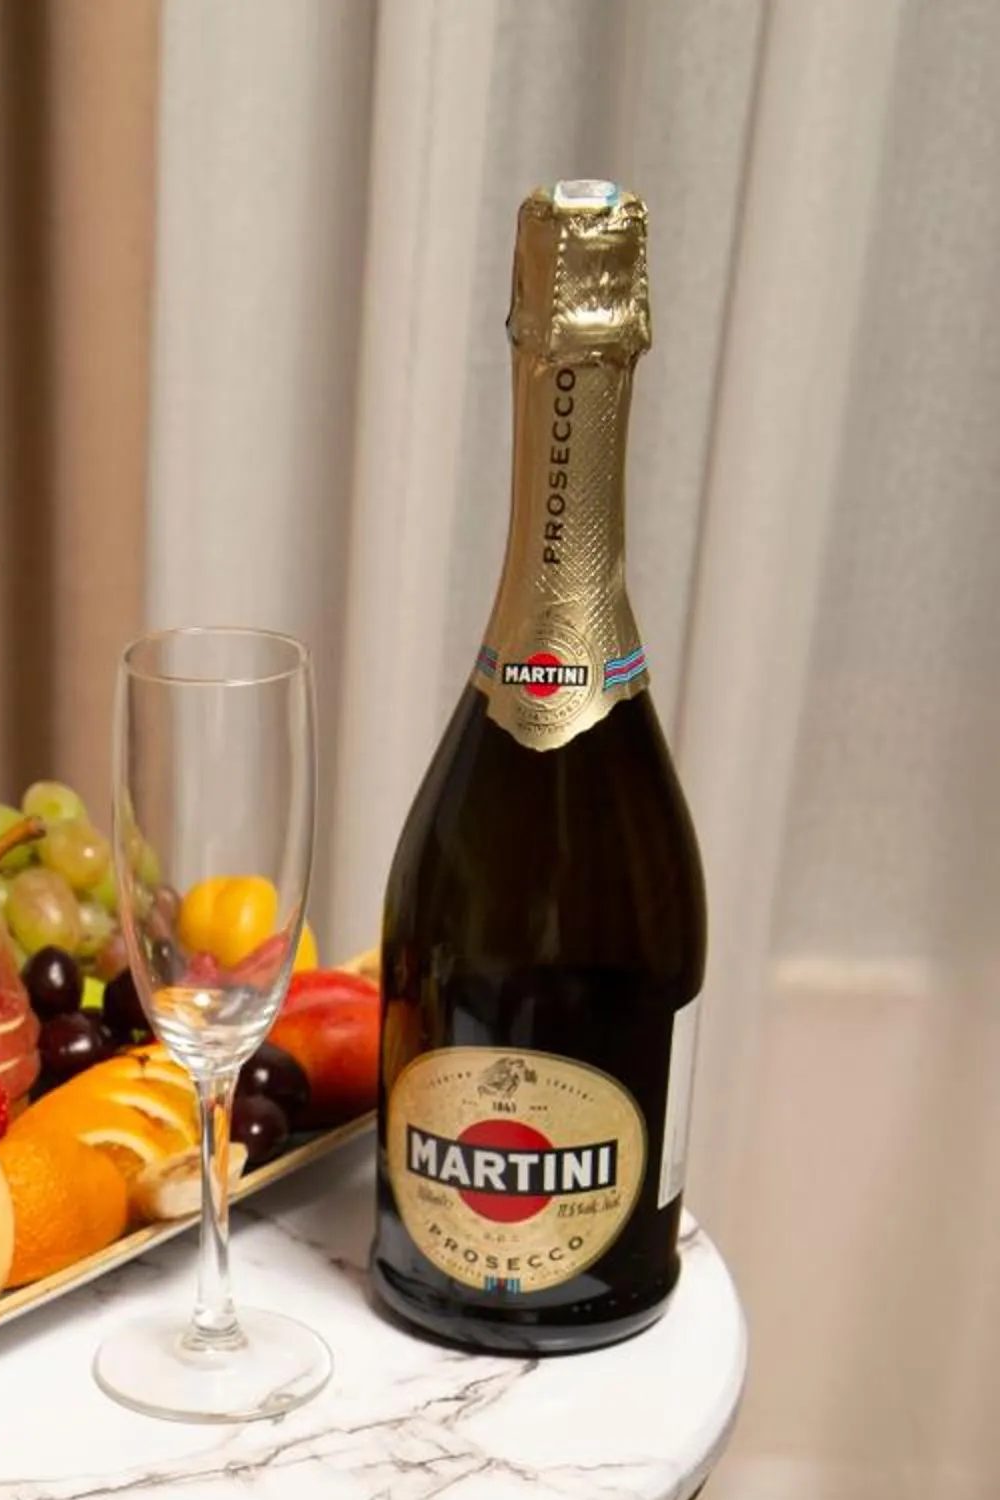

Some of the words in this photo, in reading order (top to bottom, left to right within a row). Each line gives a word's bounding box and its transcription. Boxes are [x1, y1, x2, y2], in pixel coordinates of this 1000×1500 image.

[543, 368, 576, 564] PROSECCO
[504, 665, 585, 684] MARTINI
[411, 1132, 611, 1191] MARTINI
[429, 1223, 583, 1270] PROSECCO
